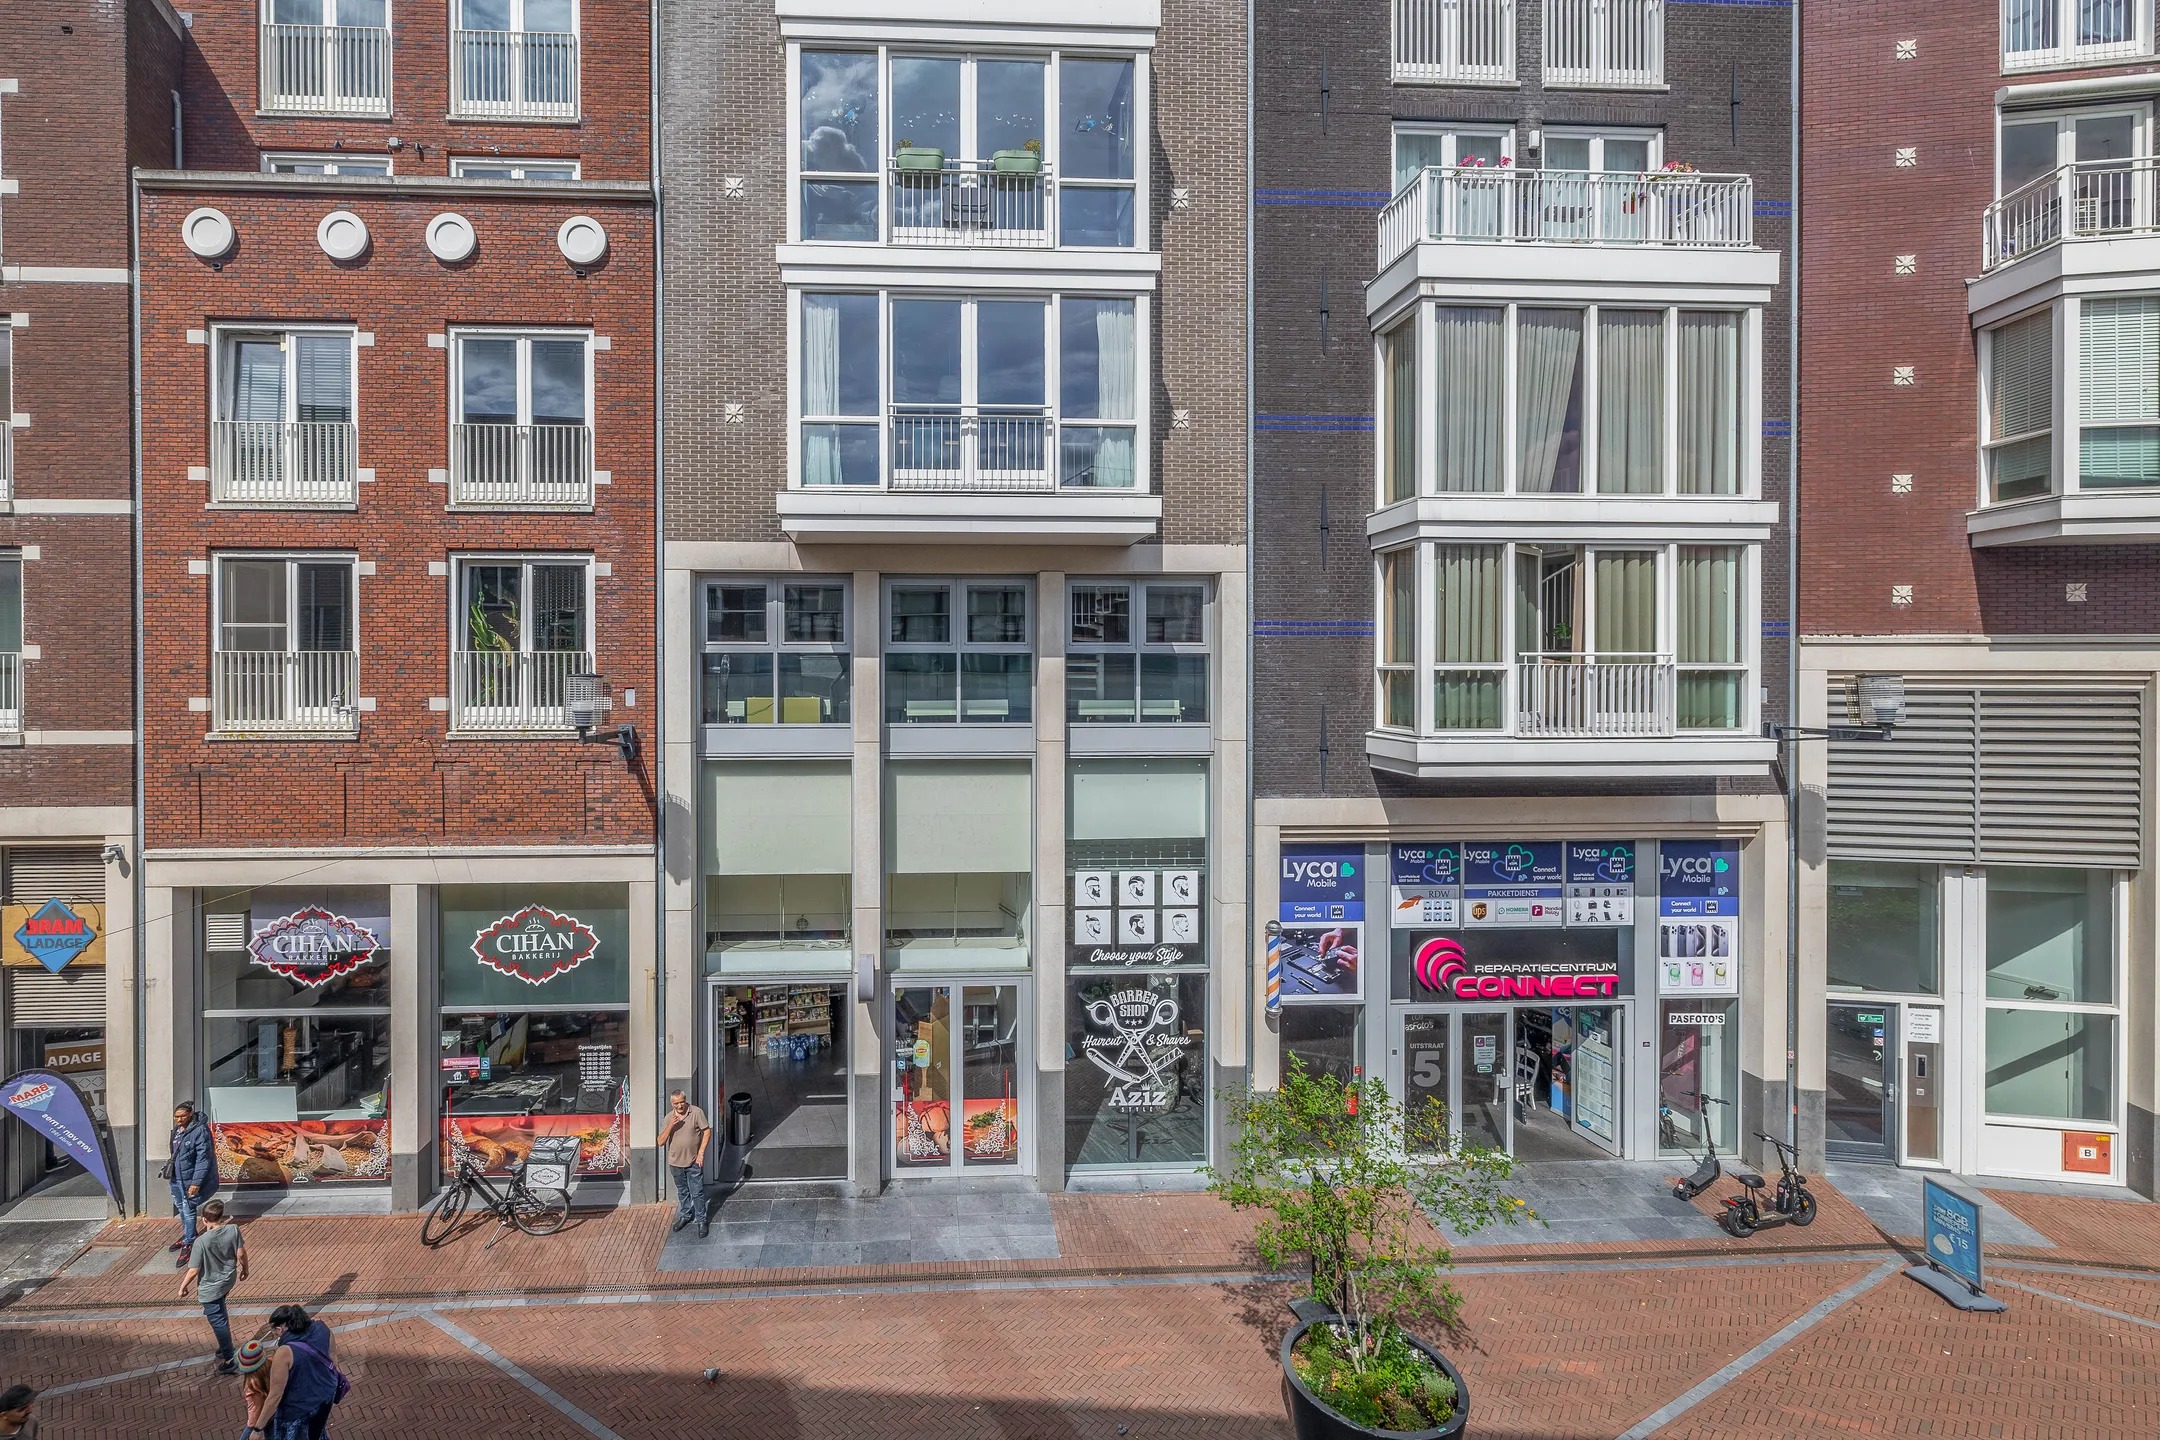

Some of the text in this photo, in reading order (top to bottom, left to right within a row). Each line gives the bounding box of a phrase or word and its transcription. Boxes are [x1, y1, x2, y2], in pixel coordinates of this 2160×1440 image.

[1399, 849, 1425, 861] Lyca
[1464, 849, 1490, 861] Lyca
[1573, 847, 1600, 859] Lyca
[1283, 858, 1337, 881] Lyca
[1660, 854, 1711, 877] Lyca
[1307, 879, 1337, 888] Mobile
[1682, 874, 1711, 883] Mobile
[1428, 890, 1450, 898] RDW
[26, 918, 84, 935] BRAM
[27, 938, 83, 949] LADAGE
[272, 934, 352, 953] CIHAN
[496, 932, 575, 953] CIHAN
[512, 952, 561, 960] BAKKERIJ
[1090, 947, 1184, 966] Choose your Style
[1474, 963, 1617, 974] REPARATIECENTRUM
[1453, 974, 1620, 998] CONNECT
[1109, 989, 1159, 1007] BARBER
[1120, 1004, 1149, 1017] SHOP
[1405, 1020, 1434, 1031] asFoto's
[1670, 1015, 1724, 1023] PASFOTO'S
[1082, 1033, 1192, 1048] Haircut & Shaves
[45, 1052, 101, 1067] ADAGE
[1412, 1050, 1441, 1088] 5
[1108, 1086, 1166, 1106] Aziz
[2084, 1149, 2092, 1157] B
